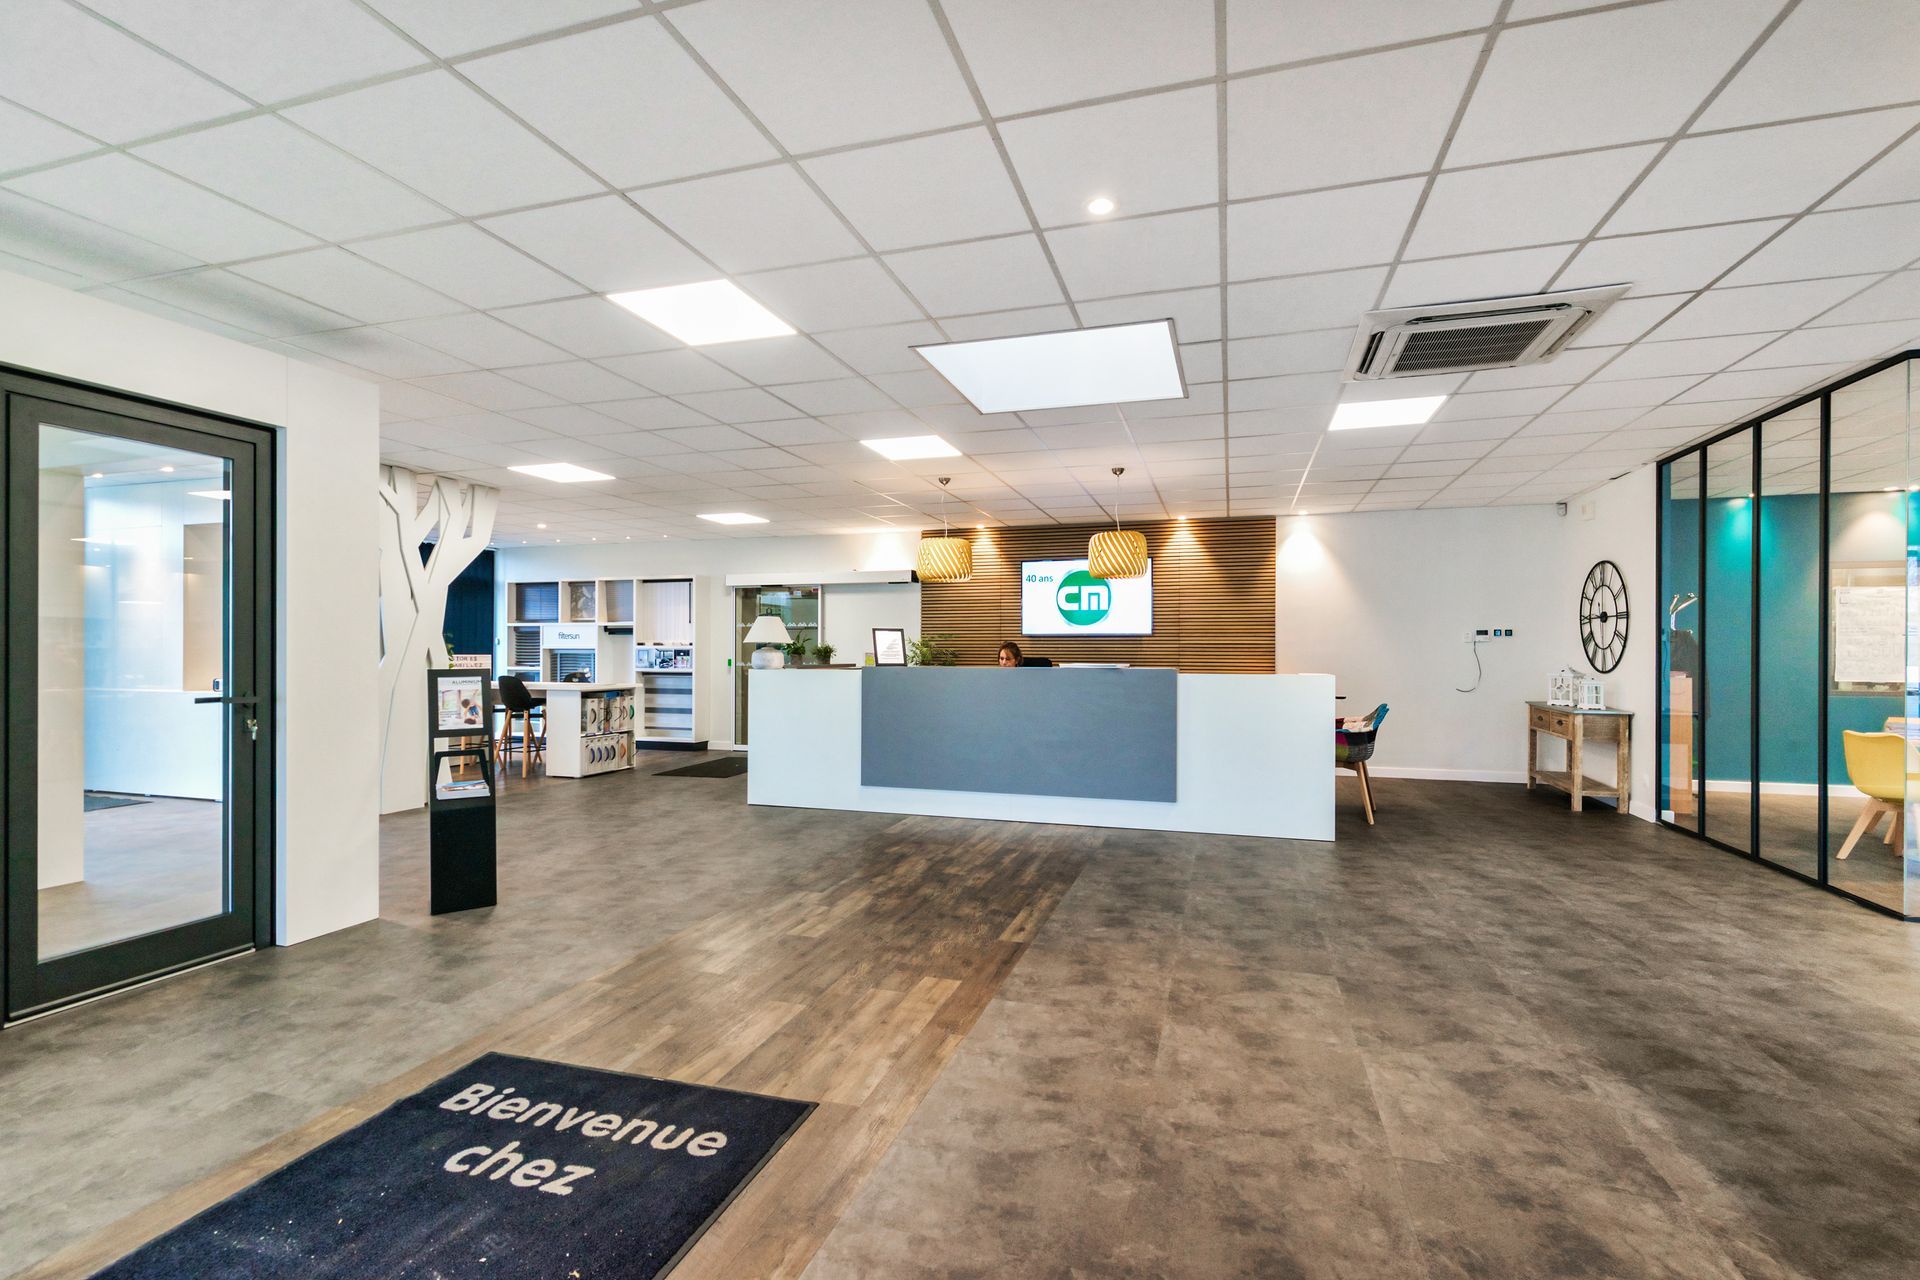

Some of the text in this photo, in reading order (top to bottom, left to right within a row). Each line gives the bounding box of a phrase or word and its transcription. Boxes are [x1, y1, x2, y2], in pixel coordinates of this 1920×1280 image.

[1025, 574, 1054, 583] 40 ans
[438, 1083, 728, 1158] Bienvenue
[442, 1141, 596, 1197] chez
